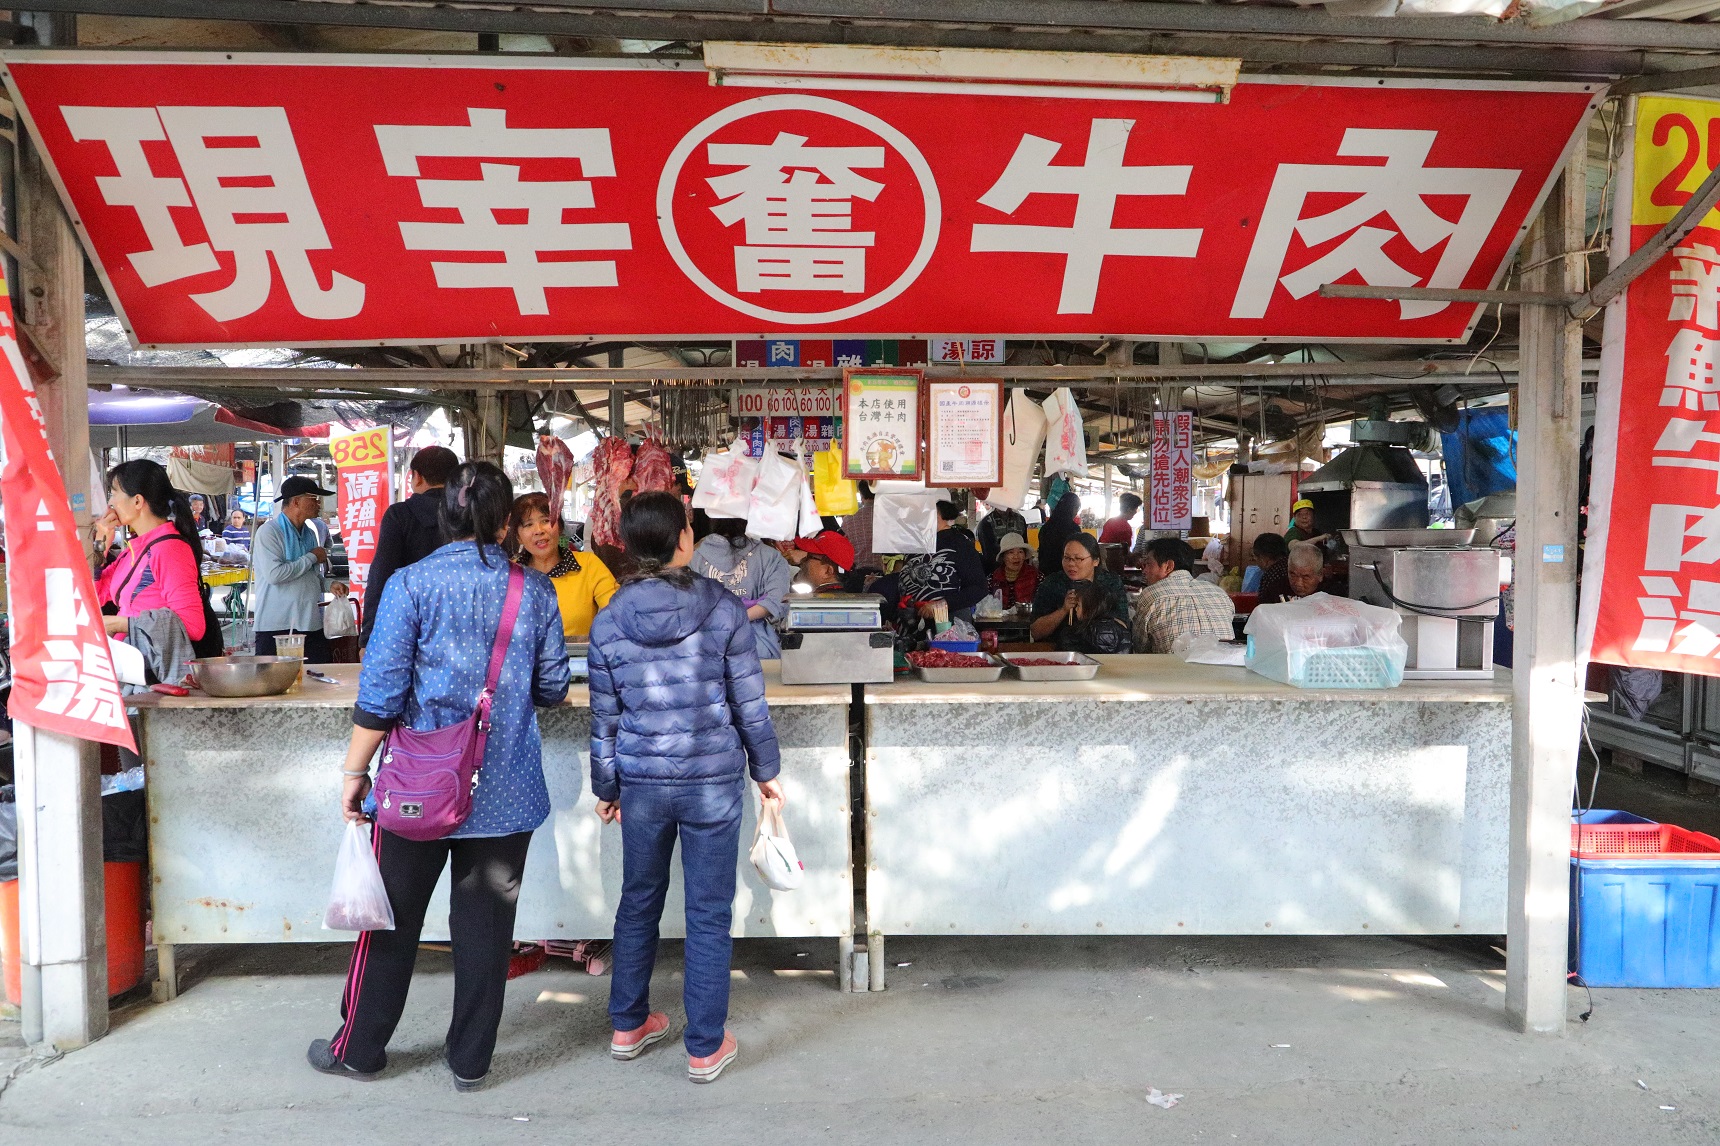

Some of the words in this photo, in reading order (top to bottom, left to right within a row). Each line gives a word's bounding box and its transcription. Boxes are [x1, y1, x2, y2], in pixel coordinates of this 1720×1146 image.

[739, 394, 763, 412] 100
[800, 398, 812, 412] 60
[815, 397, 831, 412] 100
[858, 398, 907, 410] 本店使用
[858, 411, 907, 423] 台灣牛肉
[805, 424, 818, 437] 湯
[1153, 419, 1170, 523] 請勿搶先佔位
